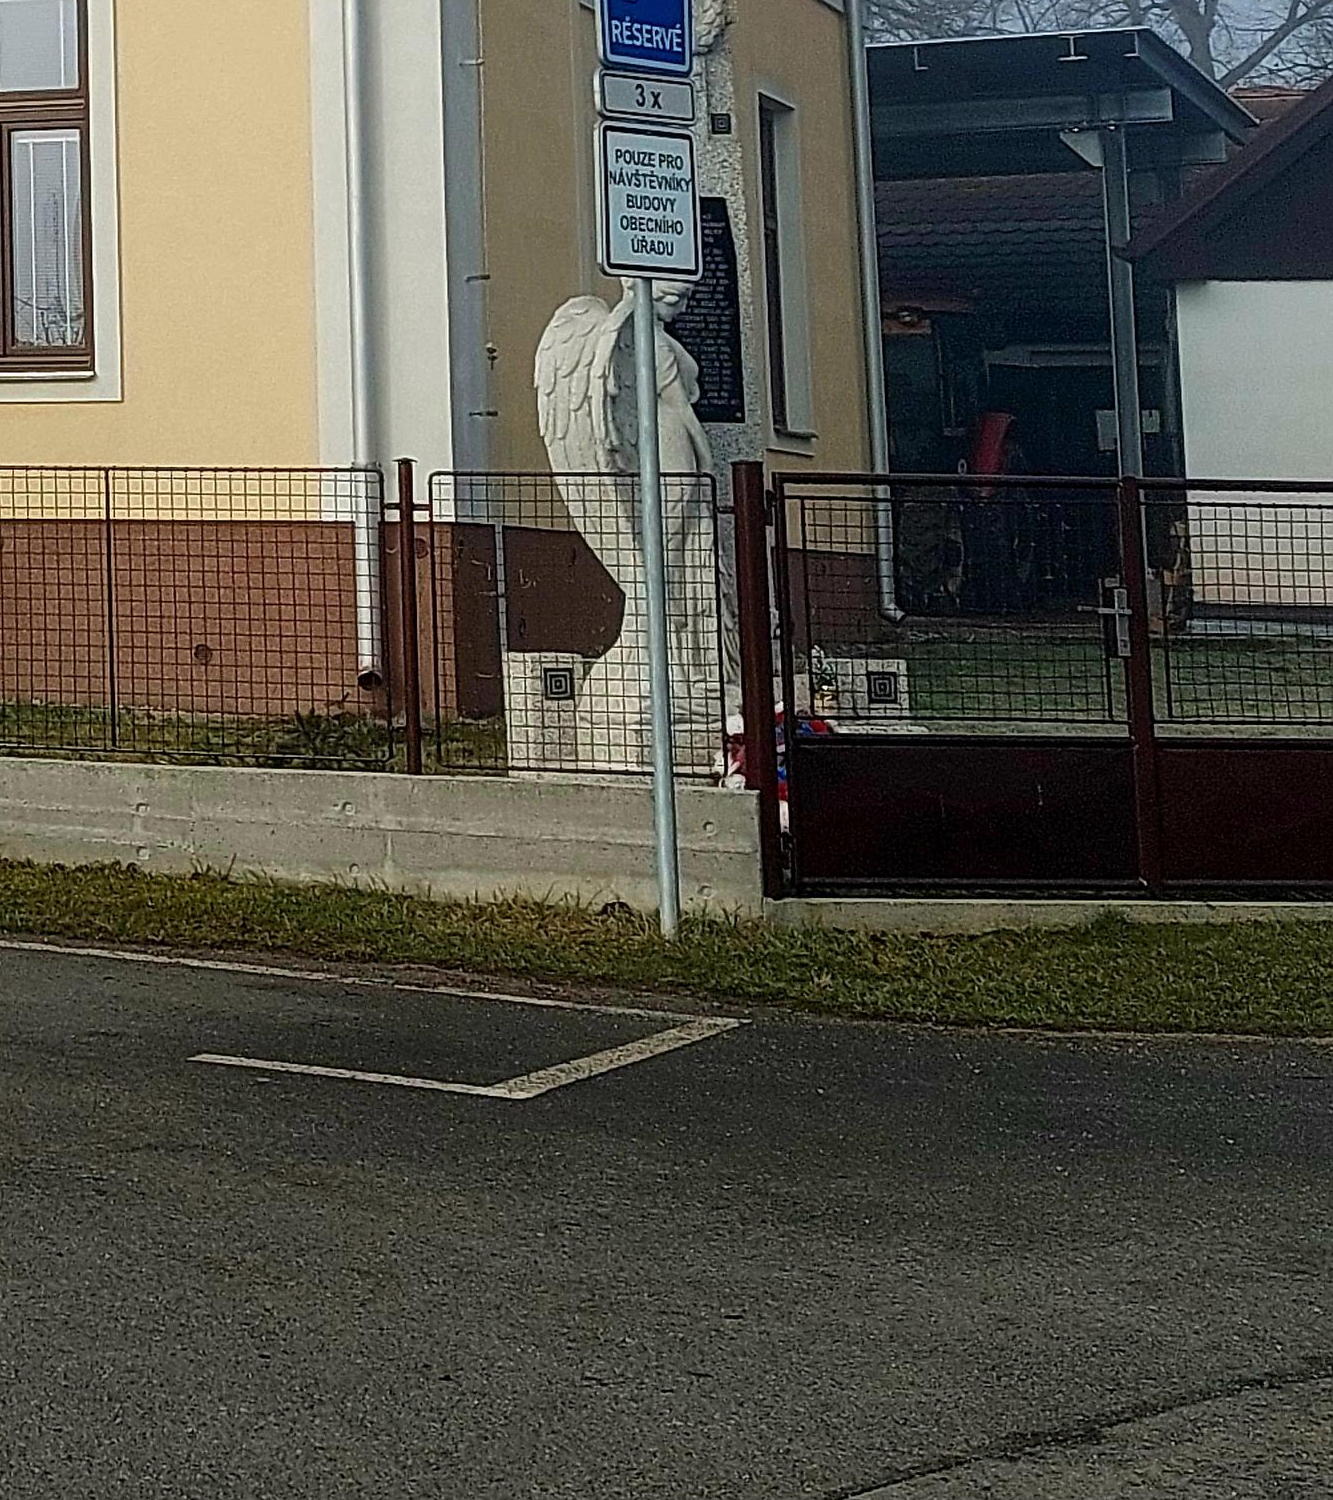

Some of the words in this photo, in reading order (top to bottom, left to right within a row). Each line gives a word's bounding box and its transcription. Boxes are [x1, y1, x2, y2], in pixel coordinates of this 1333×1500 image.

[611, 15, 682, 52] RÉSERVÉ
[635, 83, 646, 107] 3
[650, 90, 662, 109] x
[615, 148, 656, 168] POUZE
[658, 153, 684, 171] PRO
[609, 167, 692, 192] NÁVŠTĚVNÍKY
[626, 193, 677, 213] BUDOVY
[620, 215, 684, 235] OBECNÍHO
[630, 235, 674, 256] ÚŘADU
